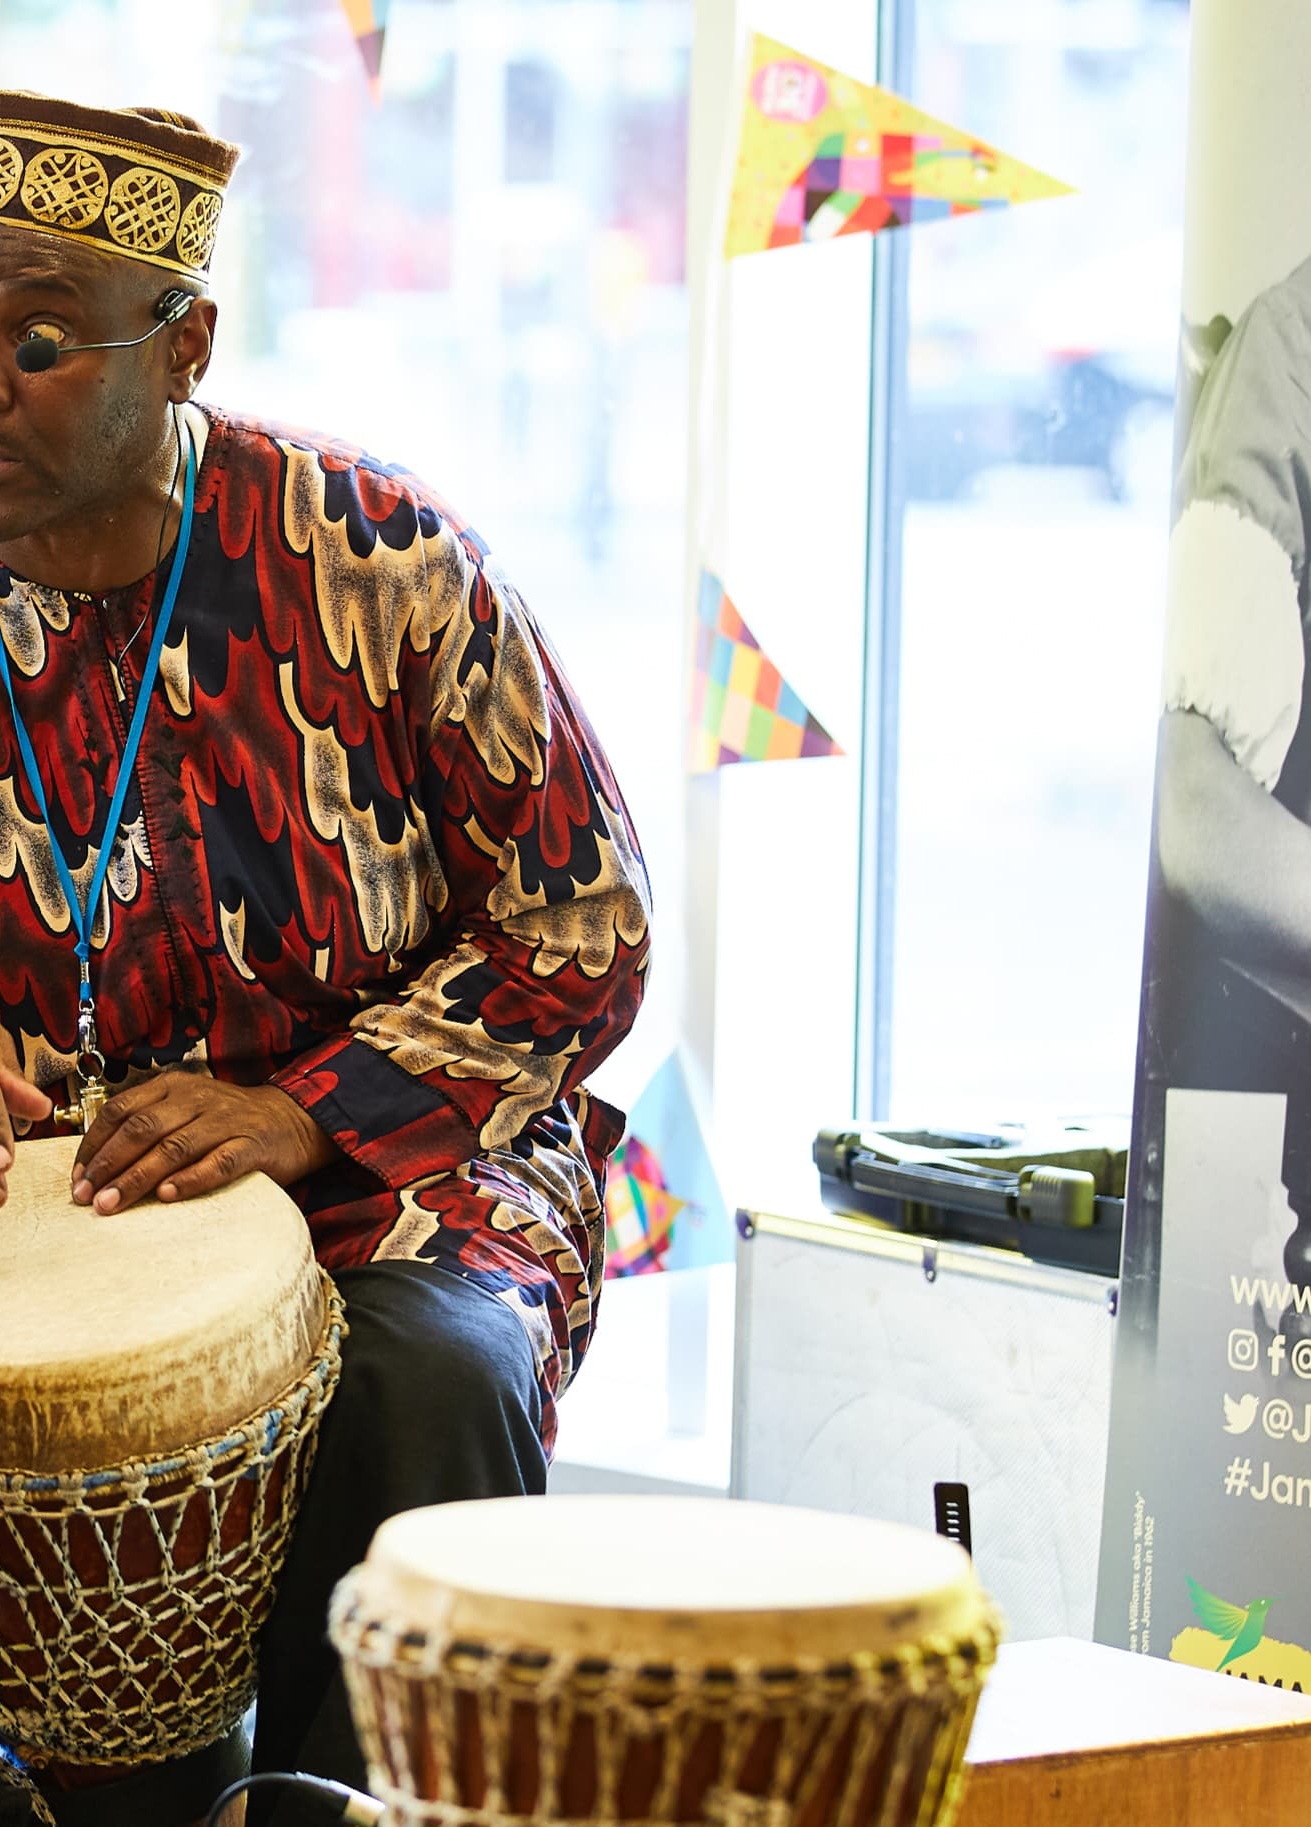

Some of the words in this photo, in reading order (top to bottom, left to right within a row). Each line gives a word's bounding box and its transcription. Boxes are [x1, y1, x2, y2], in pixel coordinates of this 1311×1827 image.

[1144, 1515, 1155, 1547] 1962
[1132, 1544, 1142, 1571] aka
[1143, 1550, 1154, 1564] in
[1128, 1573, 1141, 1632] Williams
[1141, 1565, 1153, 1628] Jamaica
